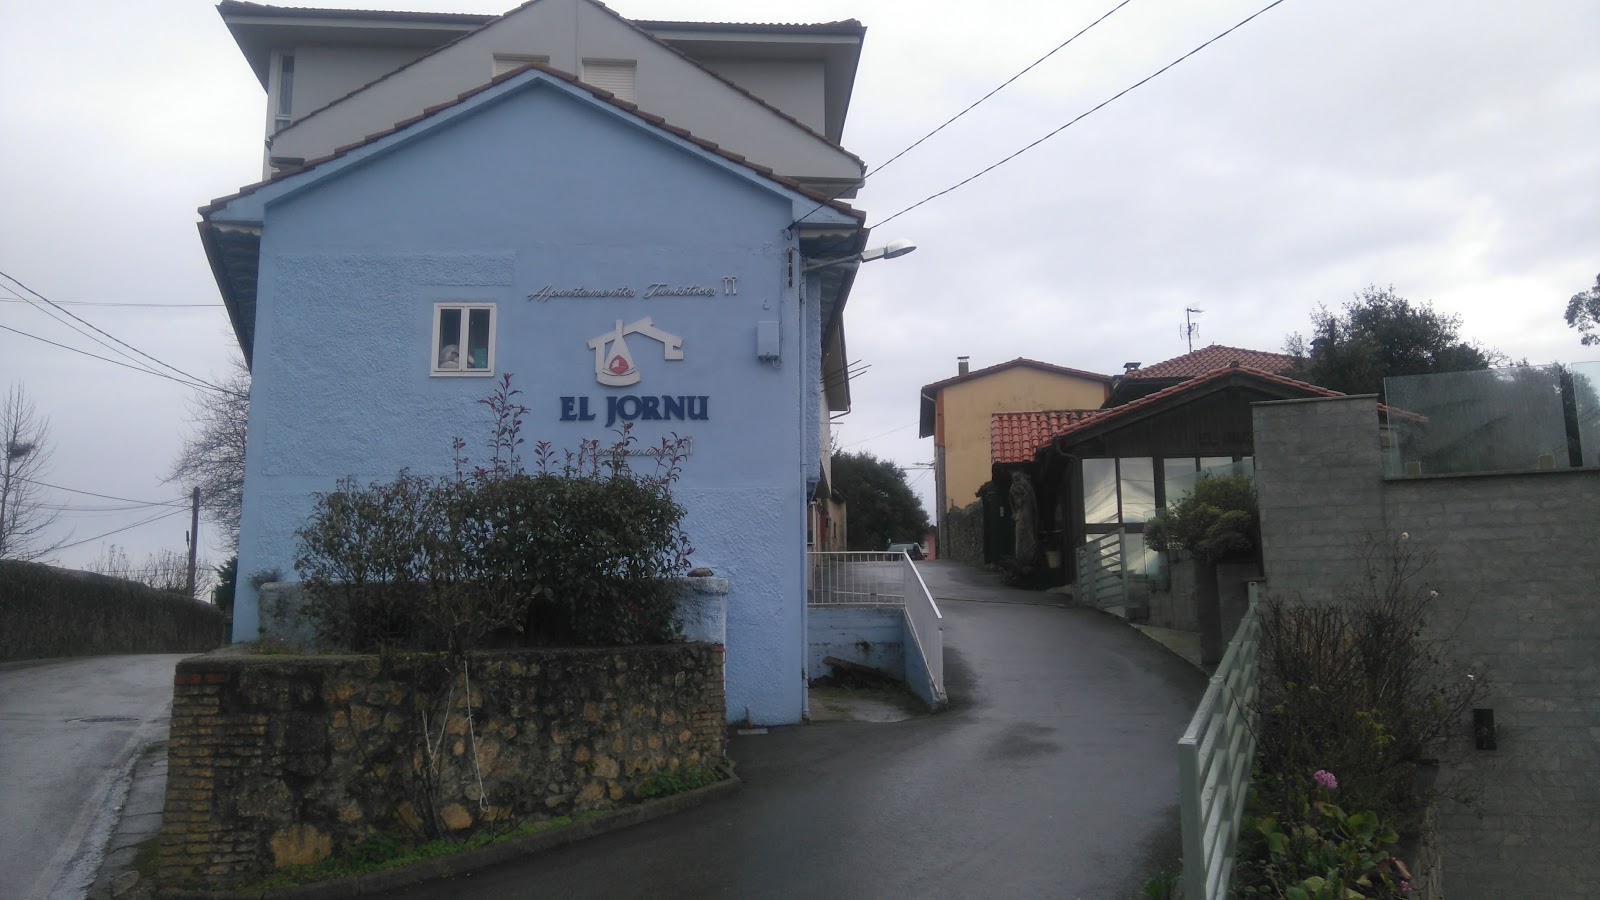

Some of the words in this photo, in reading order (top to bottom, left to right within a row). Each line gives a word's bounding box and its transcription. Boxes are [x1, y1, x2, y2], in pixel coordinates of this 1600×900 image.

[528, 283, 636, 302] Apartamentos
[560, 396, 596, 421] EL
[605, 395, 710, 427] JORNU
